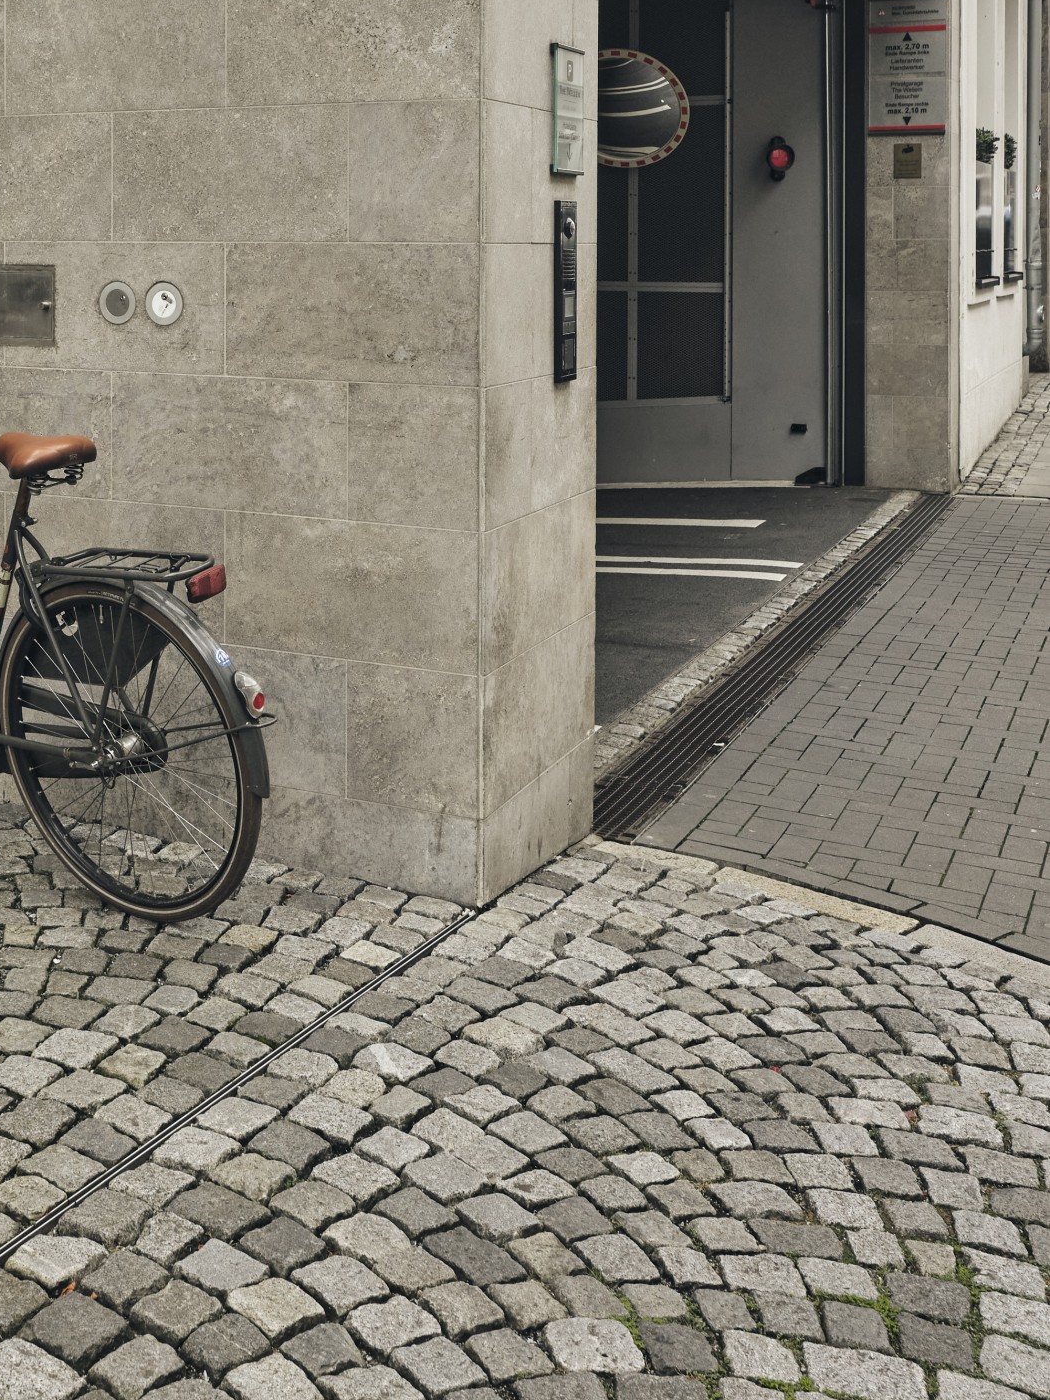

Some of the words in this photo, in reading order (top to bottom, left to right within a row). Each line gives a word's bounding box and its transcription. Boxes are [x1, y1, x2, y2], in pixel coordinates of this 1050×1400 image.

[905, 43, 920, 51] 2,70
[890, 57, 923, 65] Lieferanten
[905, 107, 919, 115] 2,10
